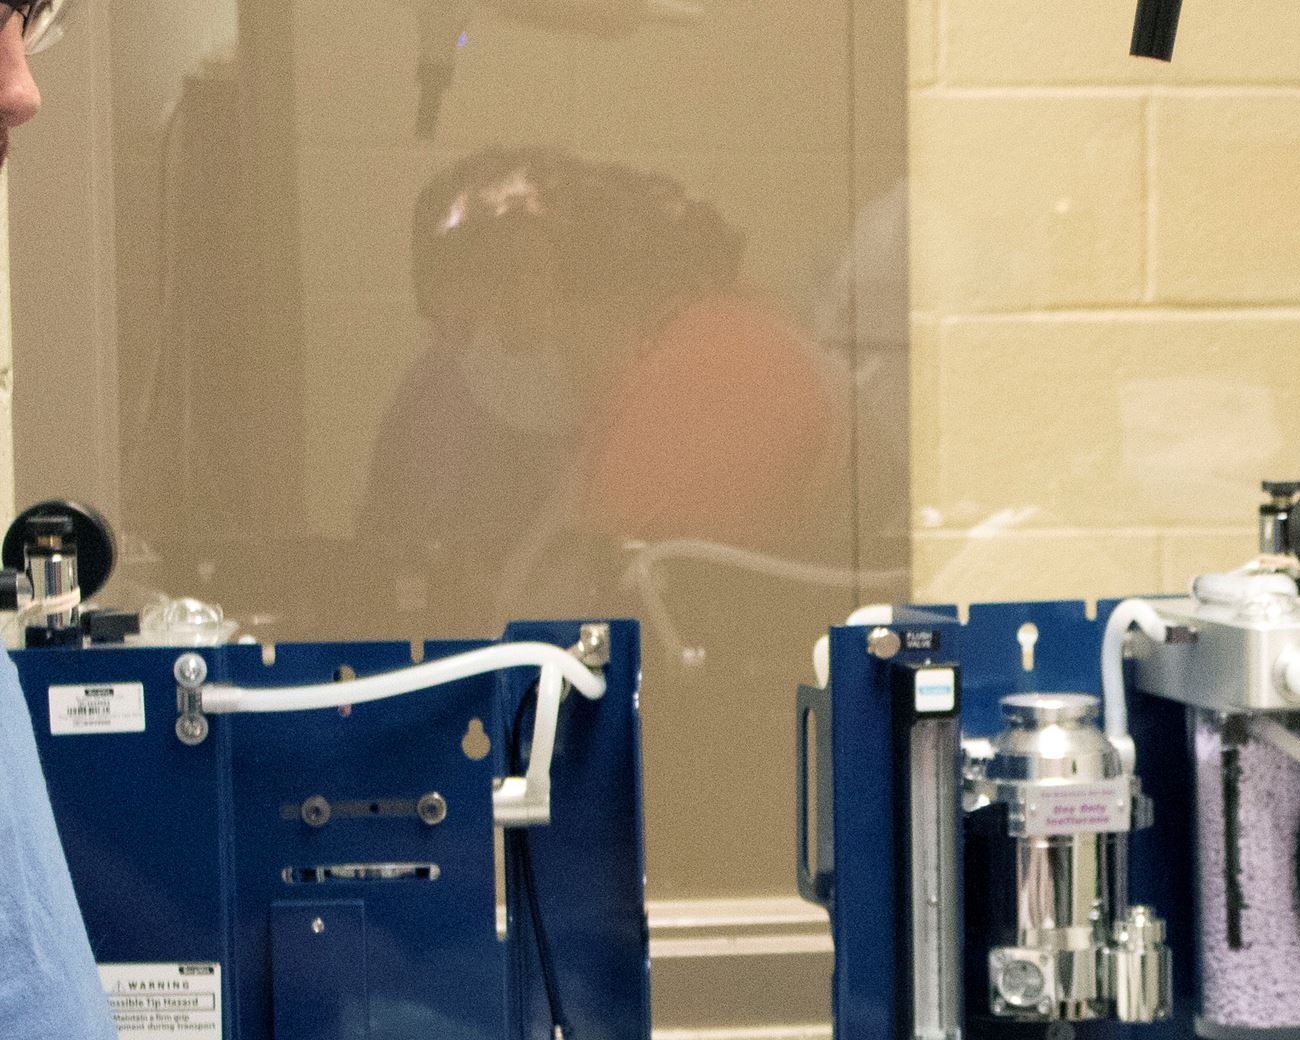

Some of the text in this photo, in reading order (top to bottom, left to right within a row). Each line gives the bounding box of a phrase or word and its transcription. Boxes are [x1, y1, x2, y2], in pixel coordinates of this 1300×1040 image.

[127, 980, 190, 991] WARNING
[147, 998, 161, 1010] Tip
[163, 998, 199, 1007] Hazard
